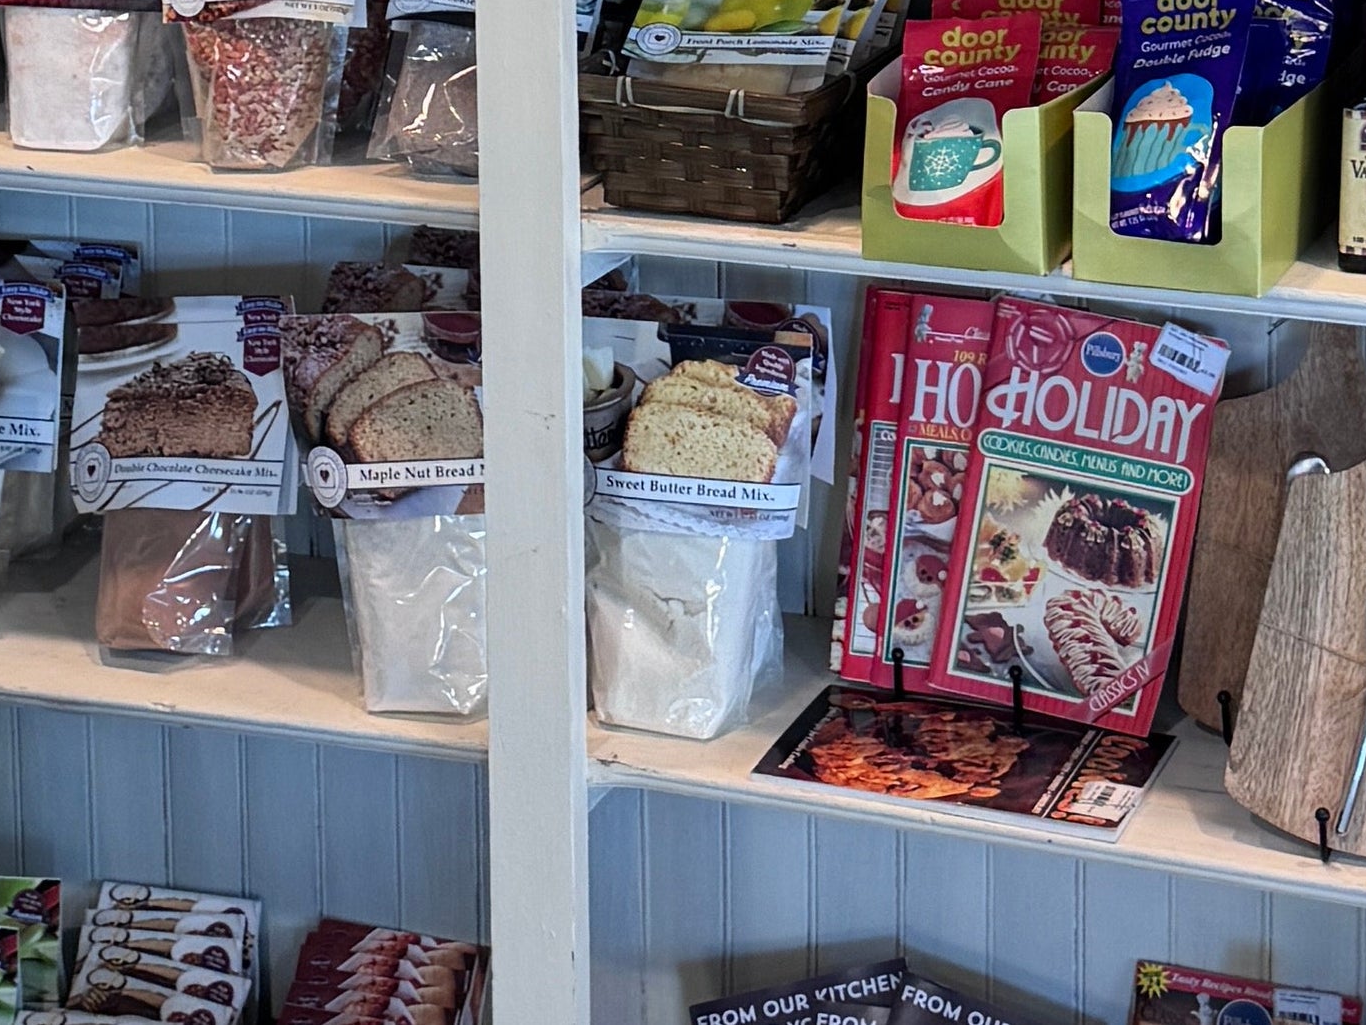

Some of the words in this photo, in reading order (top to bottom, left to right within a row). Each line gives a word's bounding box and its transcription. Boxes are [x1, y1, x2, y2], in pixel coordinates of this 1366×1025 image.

[1140, 7, 1238, 35] county
[942, 26, 1009, 49] door
[1140, 38, 1193, 54] Gourmet
[923, 44, 1022, 67] county
[1133, 49, 1185, 69] Double
[1187, 44, 1232, 62] Fudge
[922, 80, 970, 98] Candy
[974, 78, 1015, 90] Cane
[986, 366, 1206, 465] HOLIDAY
[145, 463, 193, 475] Chocolate
[359, 466, 400, 483] Maple
[404, 464, 433, 480] Nut
[434, 463, 475, 480] Bread
[1081, 450, 1117, 475] MENUS
[1121, 461, 1146, 480] AND
[606, 474, 646, 492] Sweet
[649, 480, 693, 497] Butter
[696, 483, 737, 500] Bread
[1088, 670, 1138, 713] CLASSICS
[762, 993, 810, 1015] OUR
[814, 970, 904, 1003] KITCHEN
[900, 984, 963, 1022] FROM
